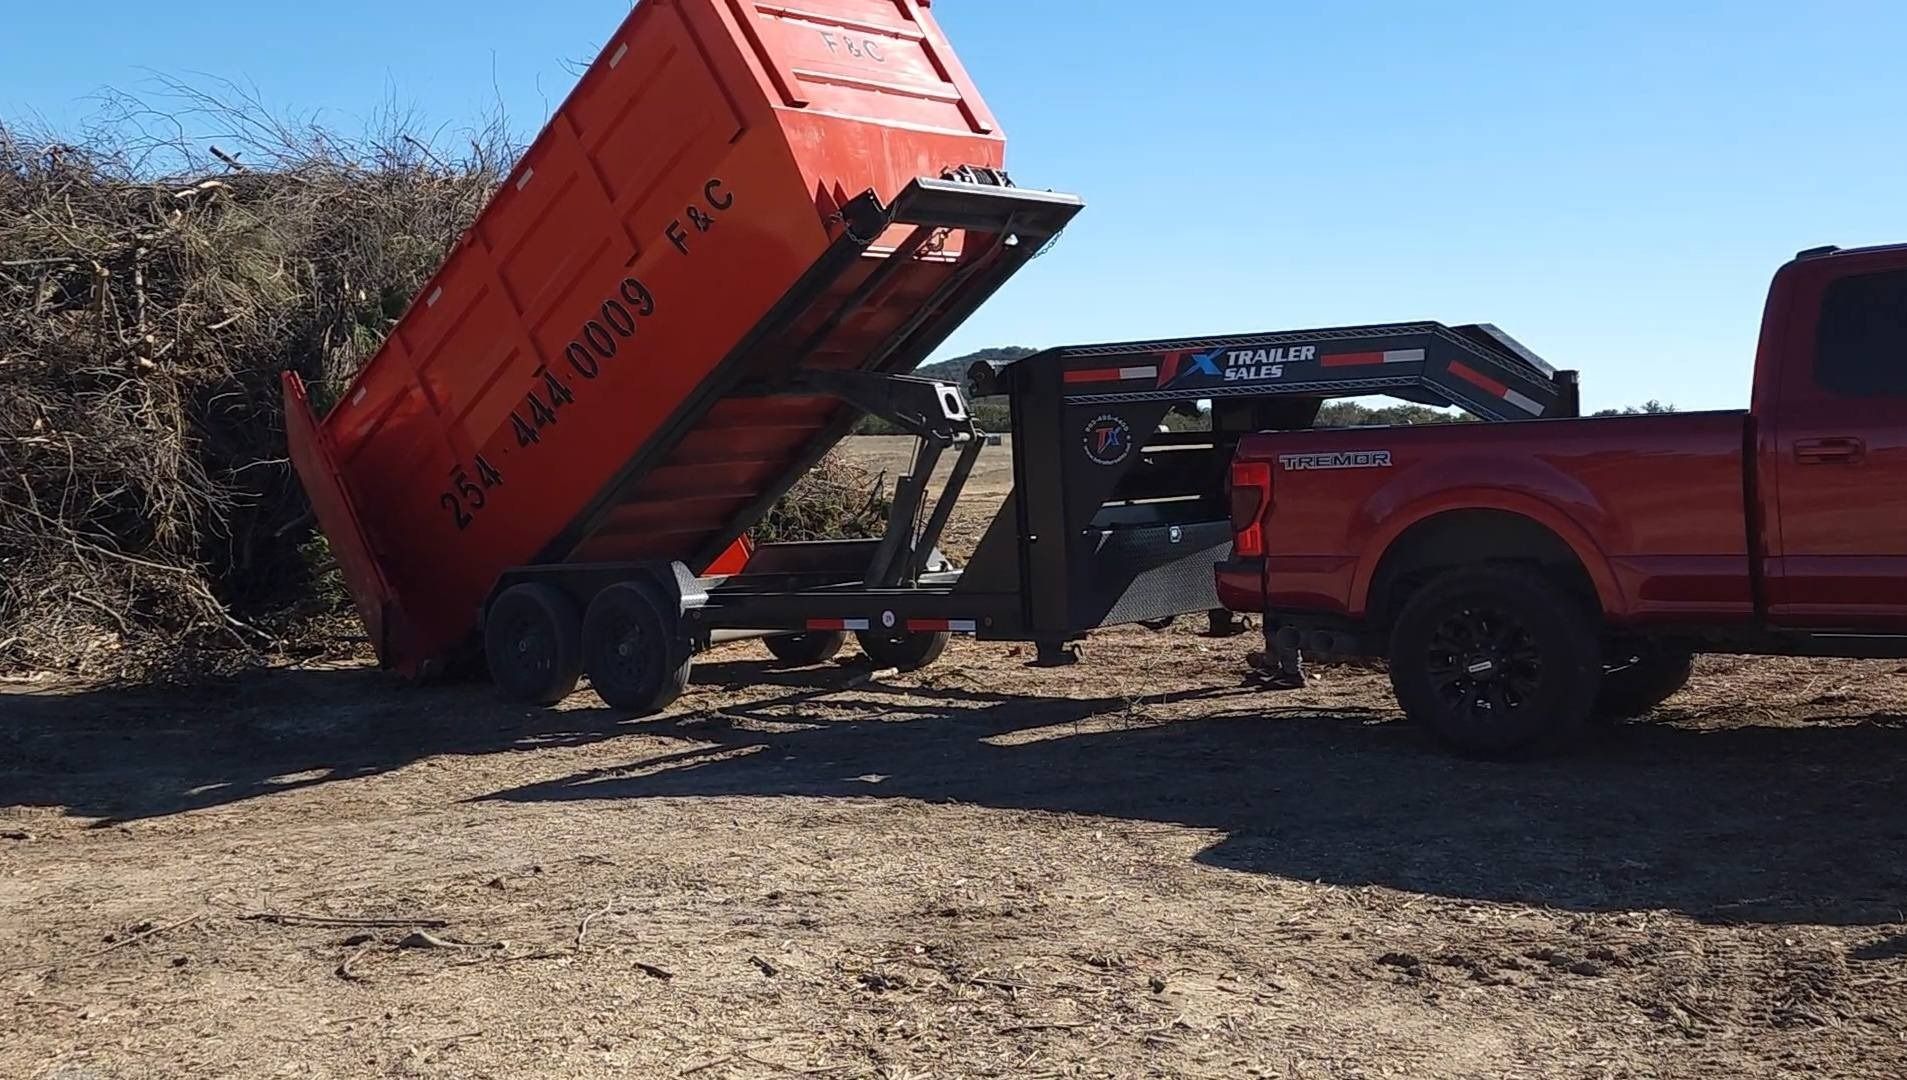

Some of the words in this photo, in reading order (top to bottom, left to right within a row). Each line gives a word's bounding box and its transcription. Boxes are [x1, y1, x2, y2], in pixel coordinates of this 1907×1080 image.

[1226, 345, 1316, 366] TRAILER
[1223, 364, 1284, 381] SALES
[1279, 450, 1392, 471] TREMOR
